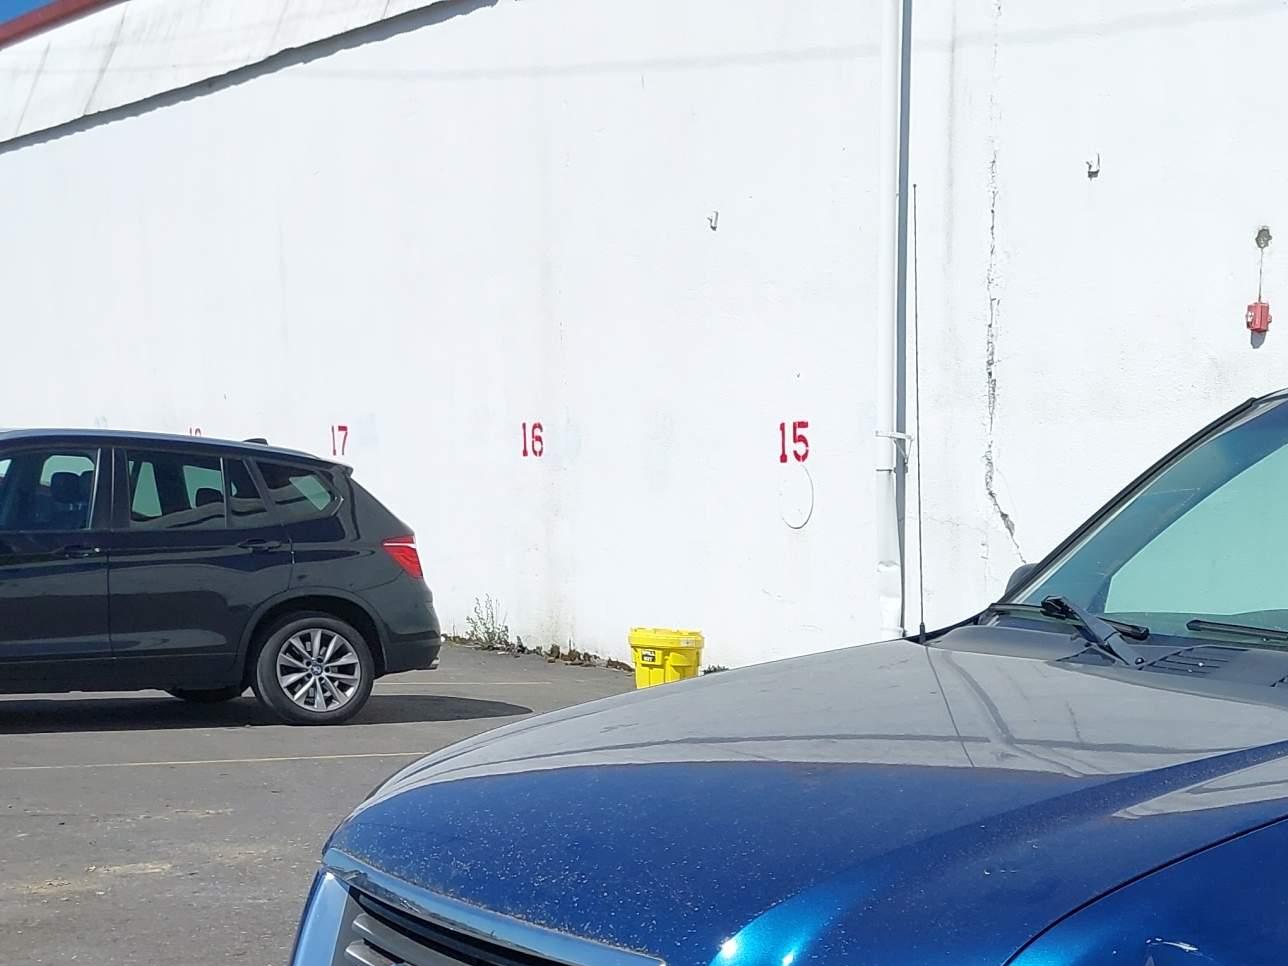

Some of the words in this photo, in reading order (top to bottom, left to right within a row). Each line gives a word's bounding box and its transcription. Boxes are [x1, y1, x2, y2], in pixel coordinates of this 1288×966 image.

[331, 425, 348, 456] 17
[522, 422, 544, 457] 16
[779, 421, 809, 463] 15
